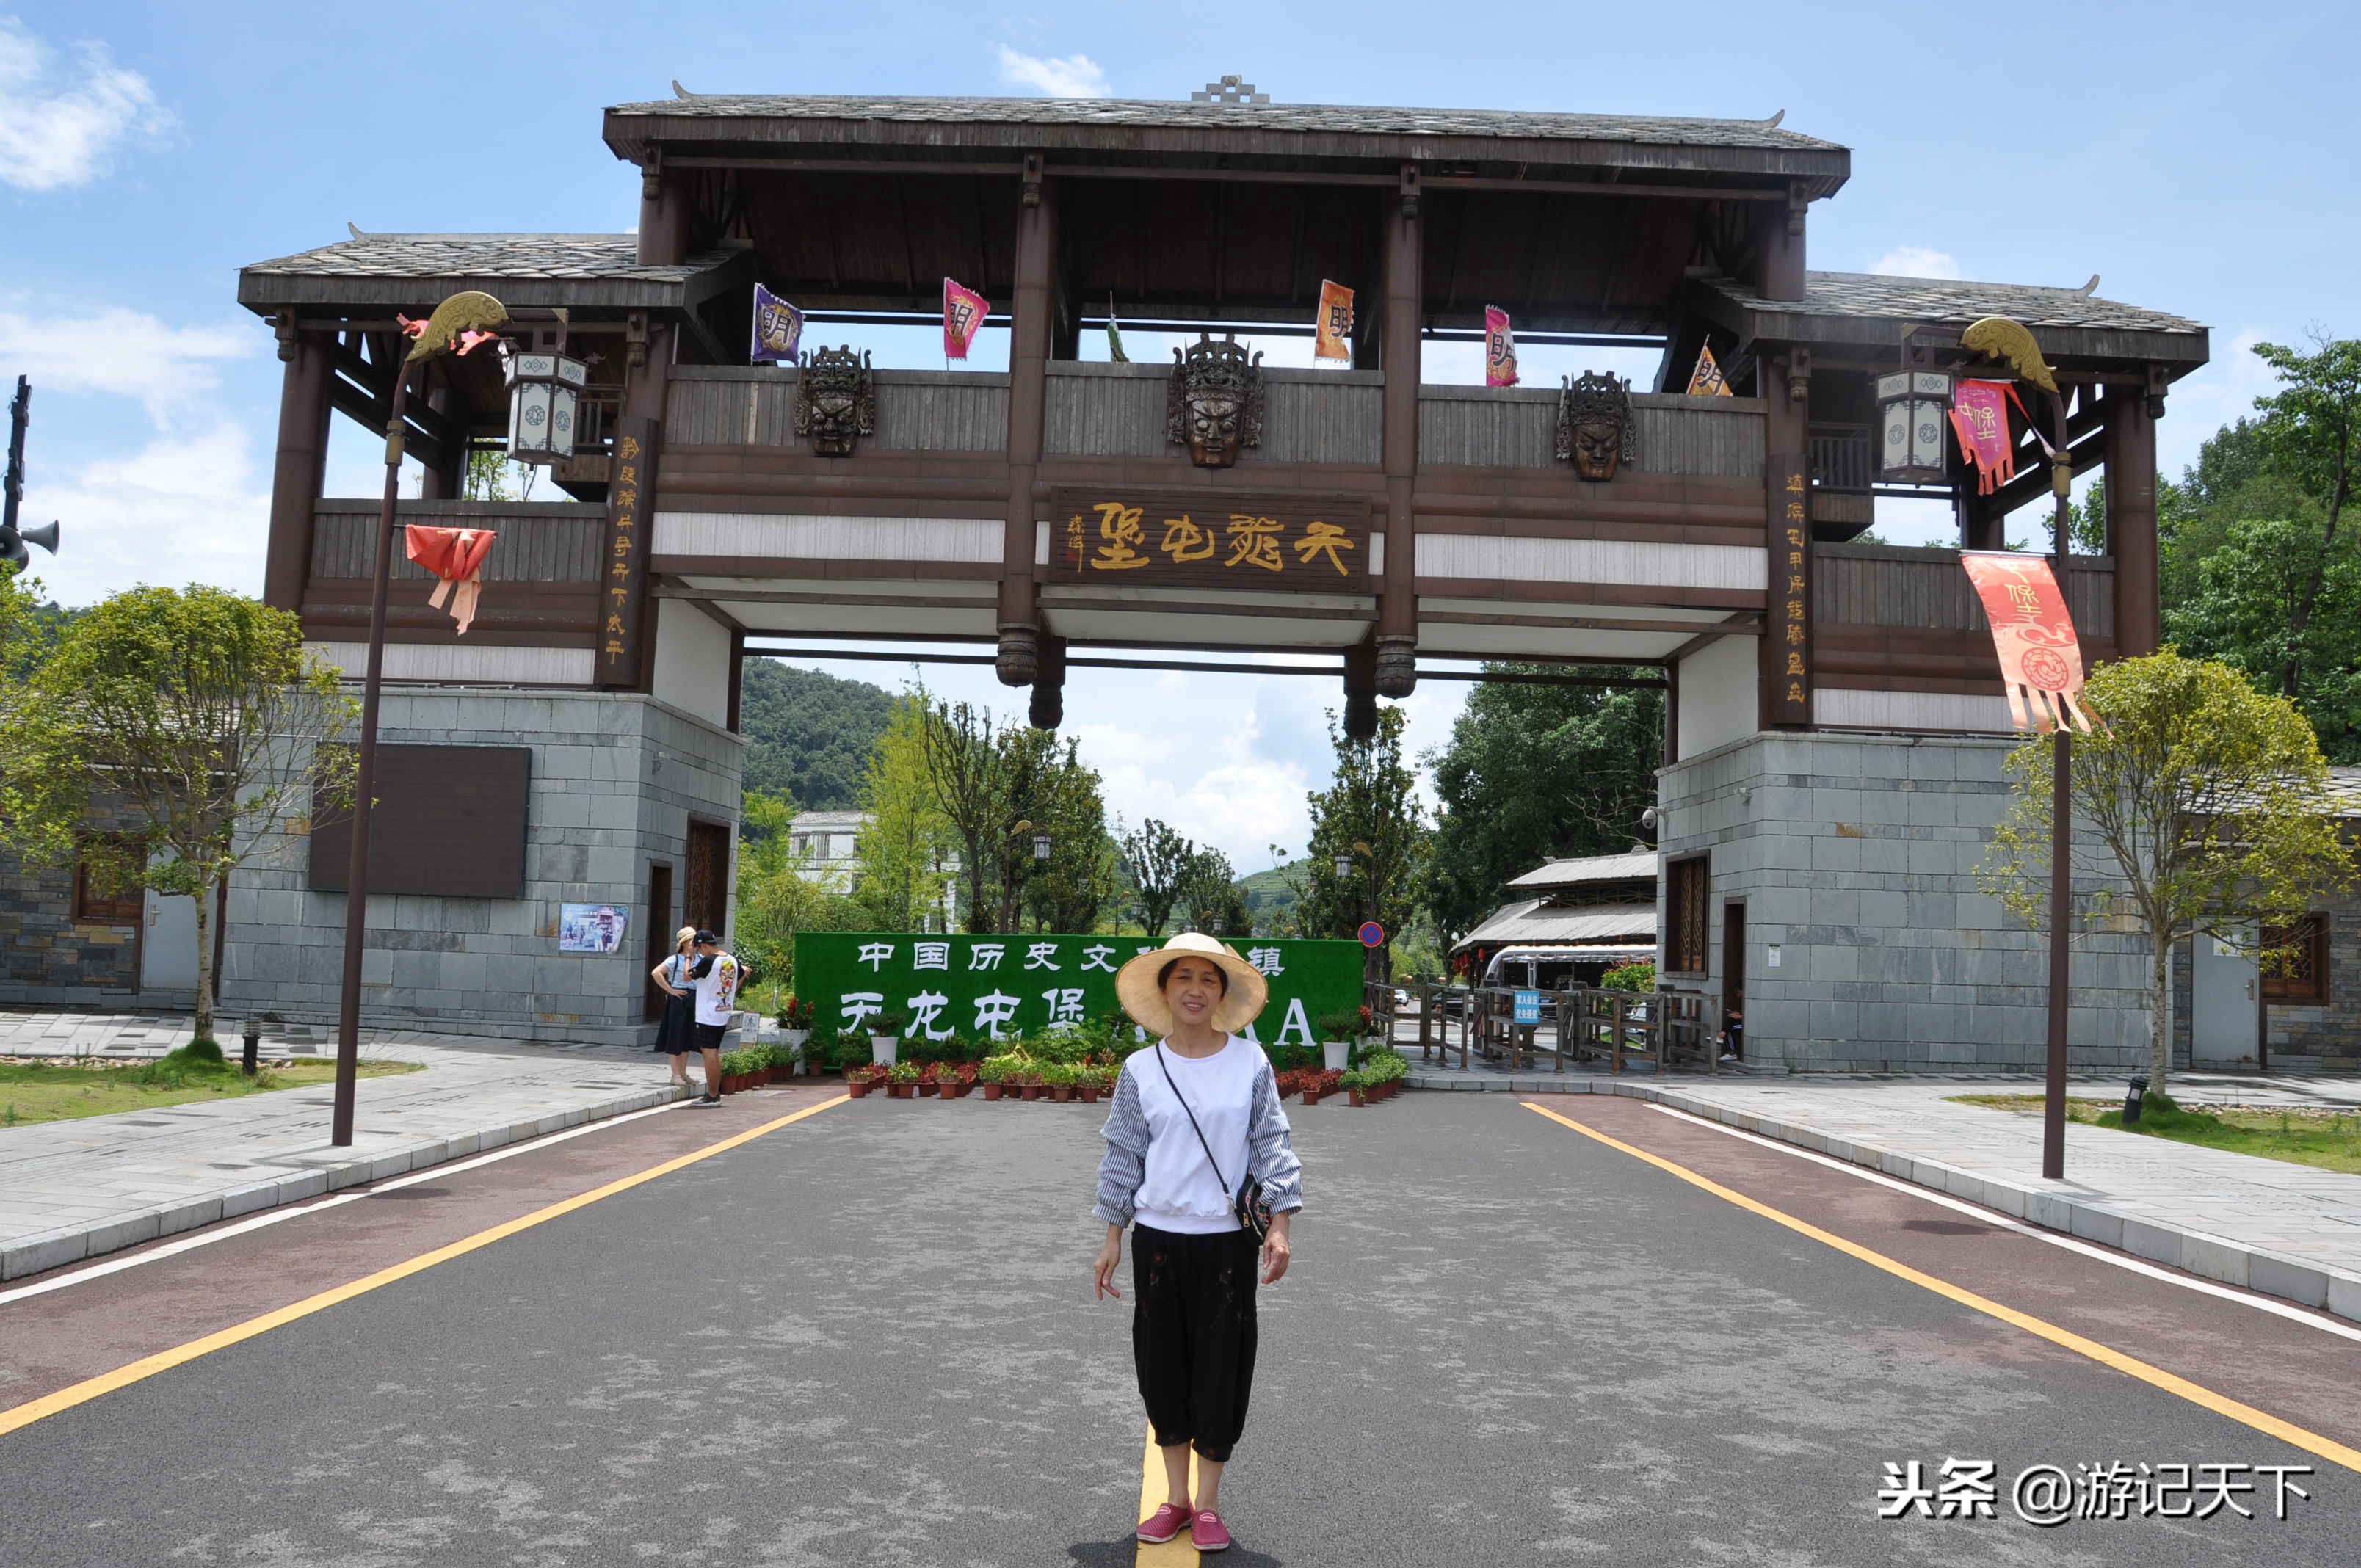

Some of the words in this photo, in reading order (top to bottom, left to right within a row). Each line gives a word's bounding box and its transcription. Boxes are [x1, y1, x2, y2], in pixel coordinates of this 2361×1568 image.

[857, 941, 1285, 978] 中国历史文镇
